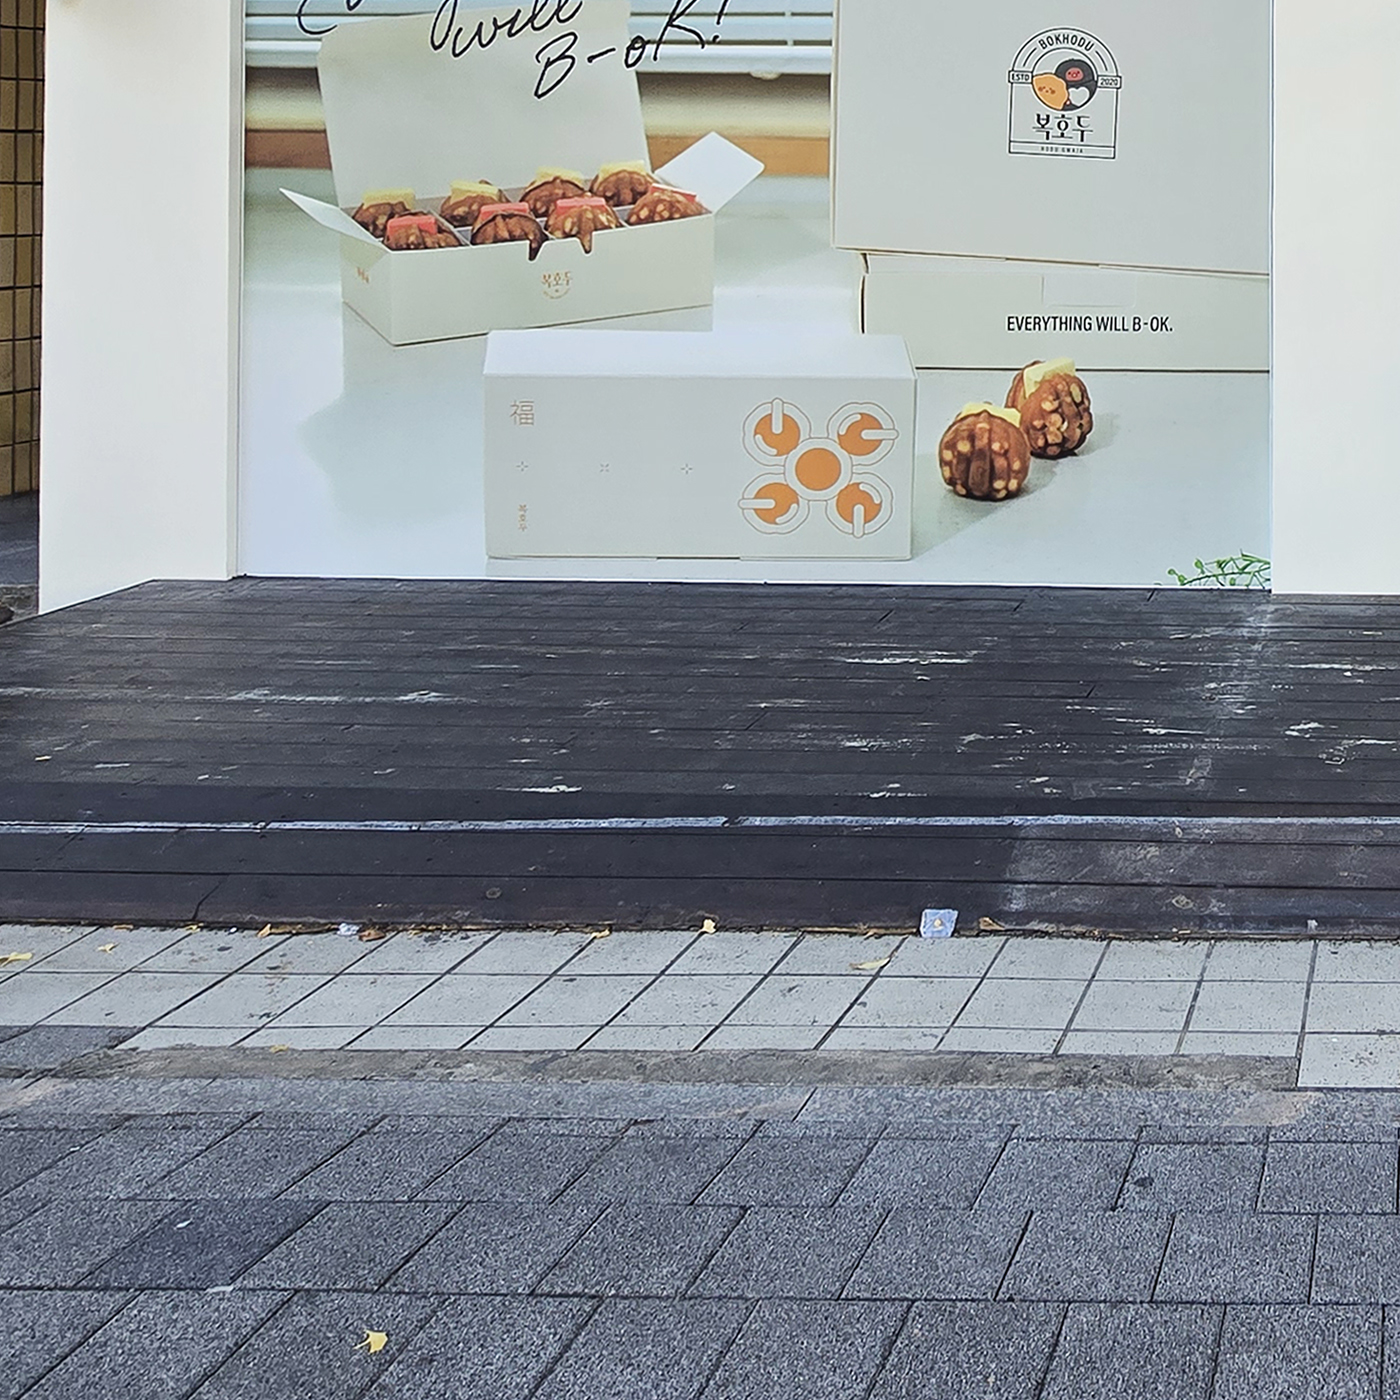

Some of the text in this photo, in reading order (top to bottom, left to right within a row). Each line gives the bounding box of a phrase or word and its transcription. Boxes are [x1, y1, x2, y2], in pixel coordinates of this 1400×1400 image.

[1038, 33, 1095, 52] BOKHODU
[1100, 77, 1119, 87] 2020
[1032, 113, 1094, 142] 복호두
[1006, 316, 1174, 333] EVERYTHING WILL B-OK.
[510, 400, 535, 426] 福
